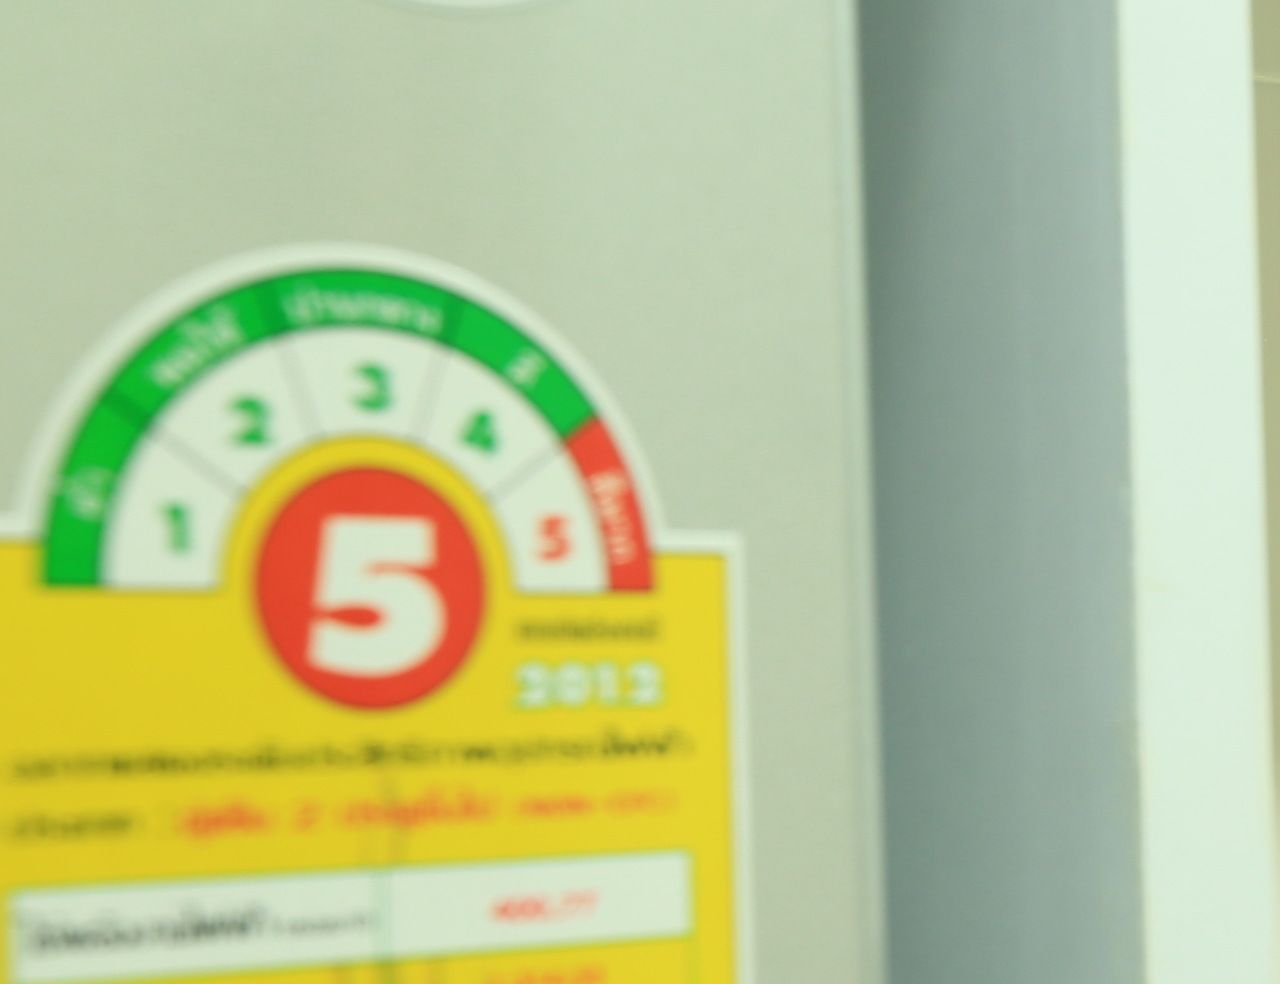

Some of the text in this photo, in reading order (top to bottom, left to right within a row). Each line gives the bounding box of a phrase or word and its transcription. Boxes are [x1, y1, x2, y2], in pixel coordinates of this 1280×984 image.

[352, 363, 393, 412] 3
[227, 397, 274, 447] 2
[460, 408, 500, 455] 4
[161, 504, 192, 557] 1
[538, 515, 571, 563] 5
[306, 513, 448, 678] 5
[514, 660, 664, 710] 2012
